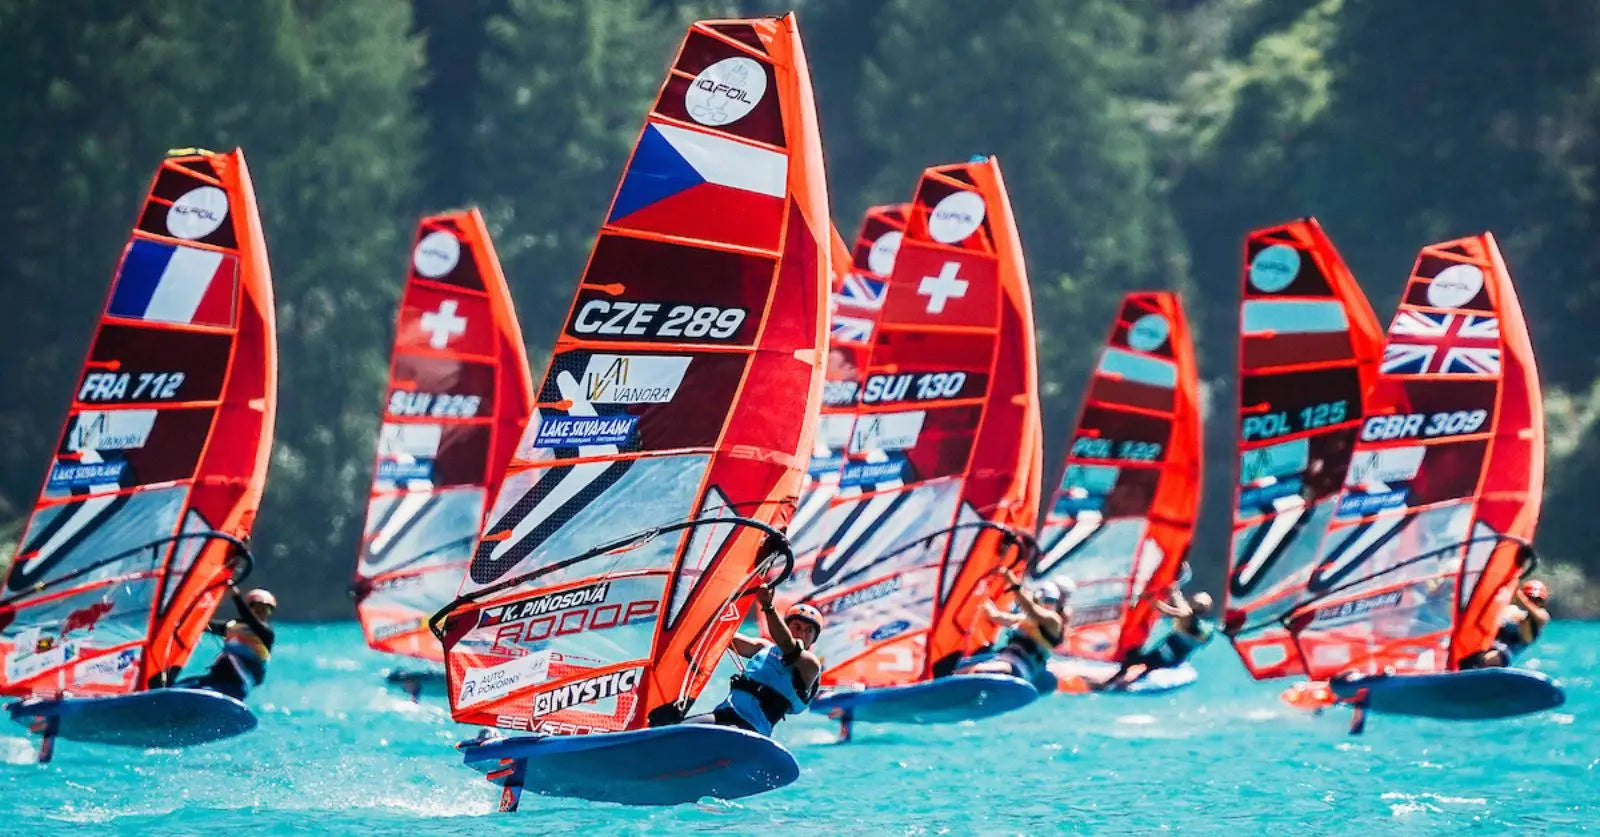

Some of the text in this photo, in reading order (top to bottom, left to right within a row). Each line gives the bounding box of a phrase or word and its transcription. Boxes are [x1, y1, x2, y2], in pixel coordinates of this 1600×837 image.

[574, 299, 746, 339] CZE 289
[78, 372, 186, 400] FRA 712
[613, 387, 671, 402] VANORA
[863, 372, 967, 402] SUI 130
[388, 390, 432, 416] SUI
[540, 418, 633, 437] LAKE SILVAPLANA
[1242, 399, 1349, 442] POL 125
[1361, 409, 1488, 441] GBR 309
[501, 604, 518, 622] K.
[480, 669, 505, 684] AUTO
[551, 668, 636, 713] MYSTIC
